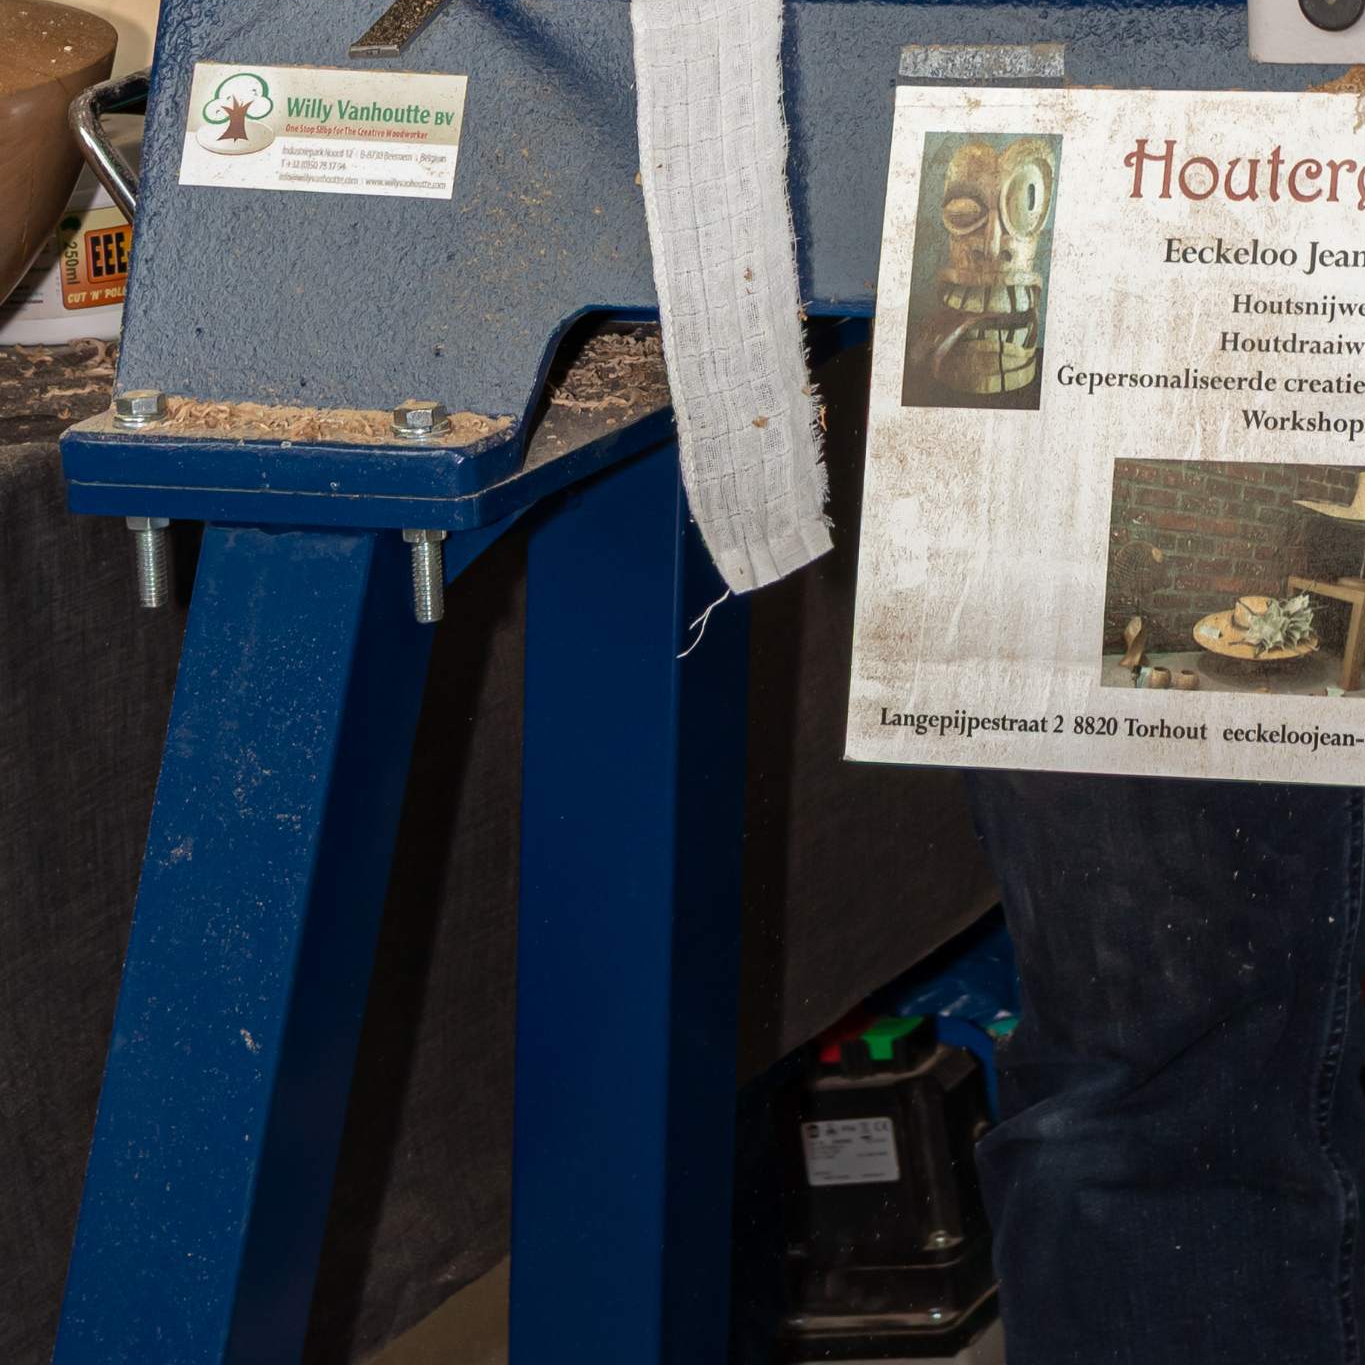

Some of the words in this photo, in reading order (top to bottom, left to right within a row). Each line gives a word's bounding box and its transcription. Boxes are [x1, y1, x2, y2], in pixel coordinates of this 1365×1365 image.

[287, 96, 333, 123] Willy
[337, 99, 431, 124] Vanhoutte
[434, 111, 455, 126] BV
[285, 123, 300, 133] One
[300, 125, 315, 135] Stop
[344, 127, 357, 137] The
[358, 128, 385, 138] Creative
[386, 129, 428, 139] Woodworker
[65, 240, 80, 285] 250ml
[1163, 237, 1298, 266] Eeckeloo
[67, 292, 87, 303] CUT
[1057, 364, 1278, 395] Gepersonaliseerde
[880, 707, 1048, 738] Langepijpestraat
[1053, 715, 1065, 734] 2
[1073, 716, 1119, 737] 8820
[1124, 718, 1208, 740] Torhout
